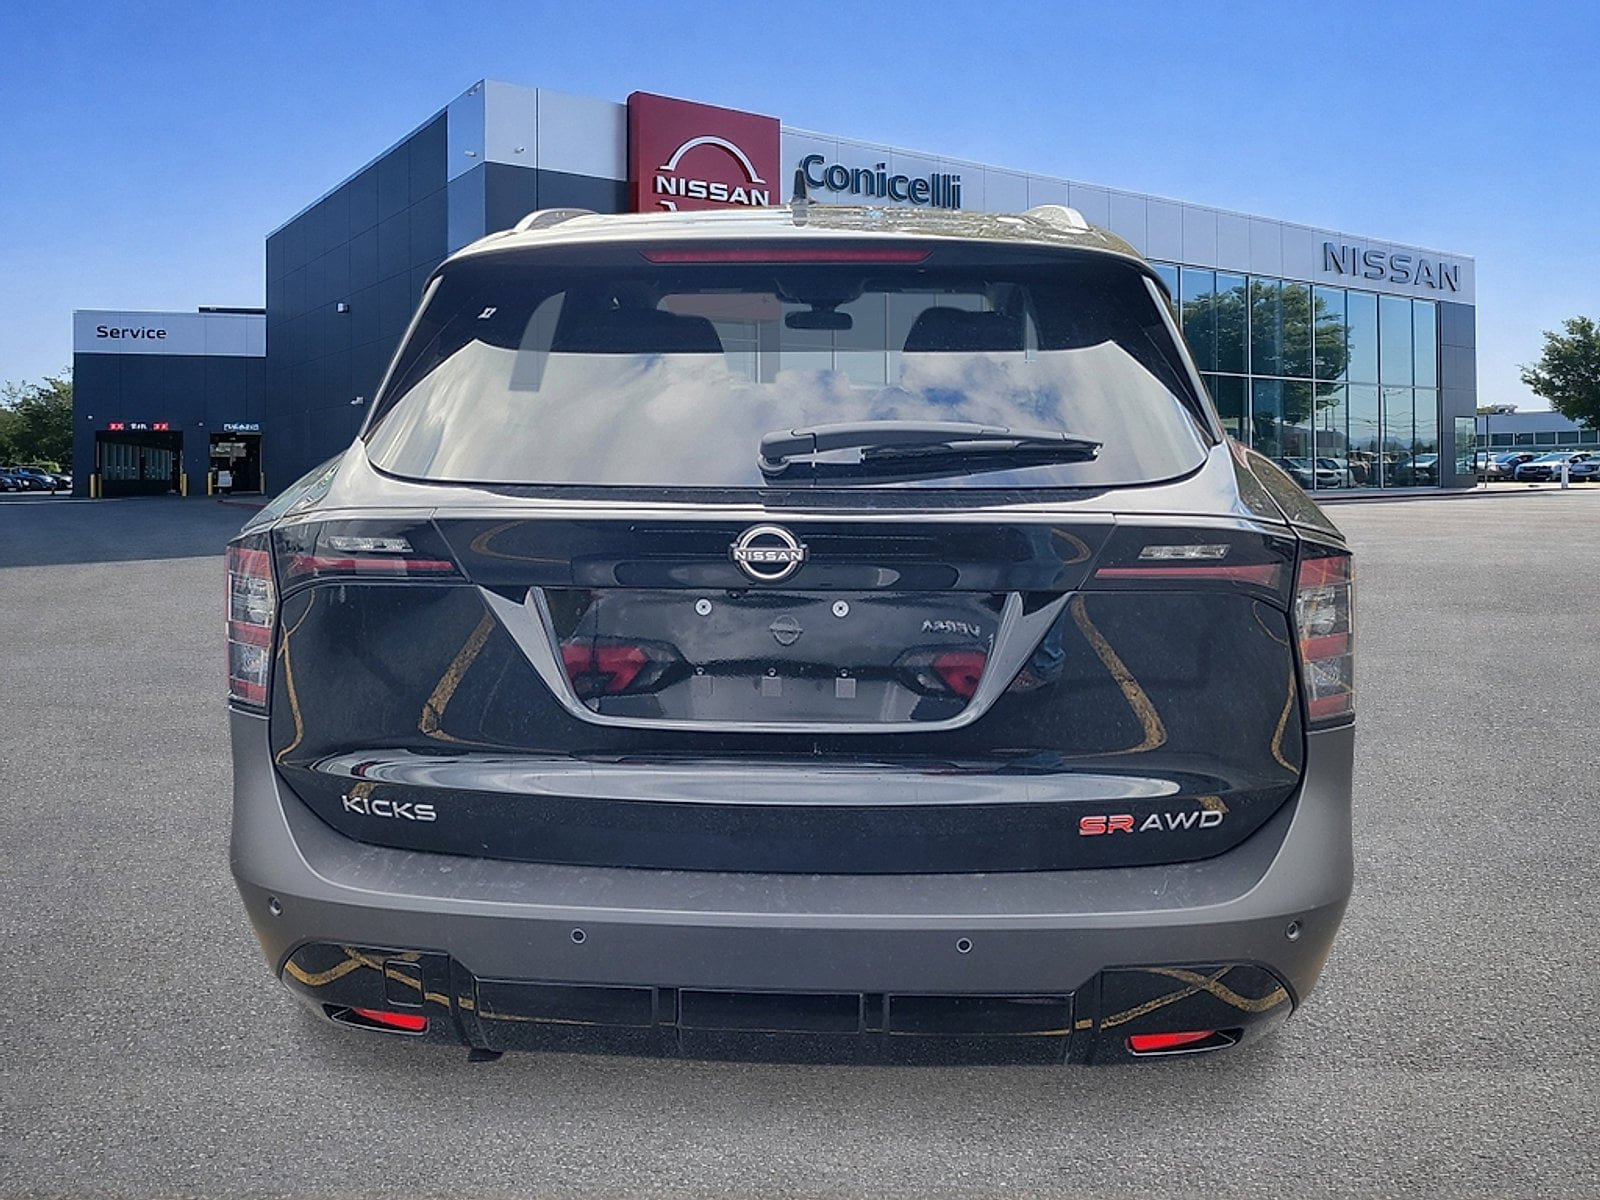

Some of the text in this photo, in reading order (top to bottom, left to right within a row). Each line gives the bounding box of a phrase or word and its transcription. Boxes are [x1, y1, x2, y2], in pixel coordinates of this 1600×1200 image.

[655, 175, 770, 207] NISSAN
[801, 154, 962, 209] Conicelli
[1323, 242, 1461, 292] NISSAN
[96, 325, 167, 339] Service
[734, 551, 803, 561] NISSAN
[341, 795, 437, 822] KICKS
[1079, 810, 1223, 836] SR AWD
